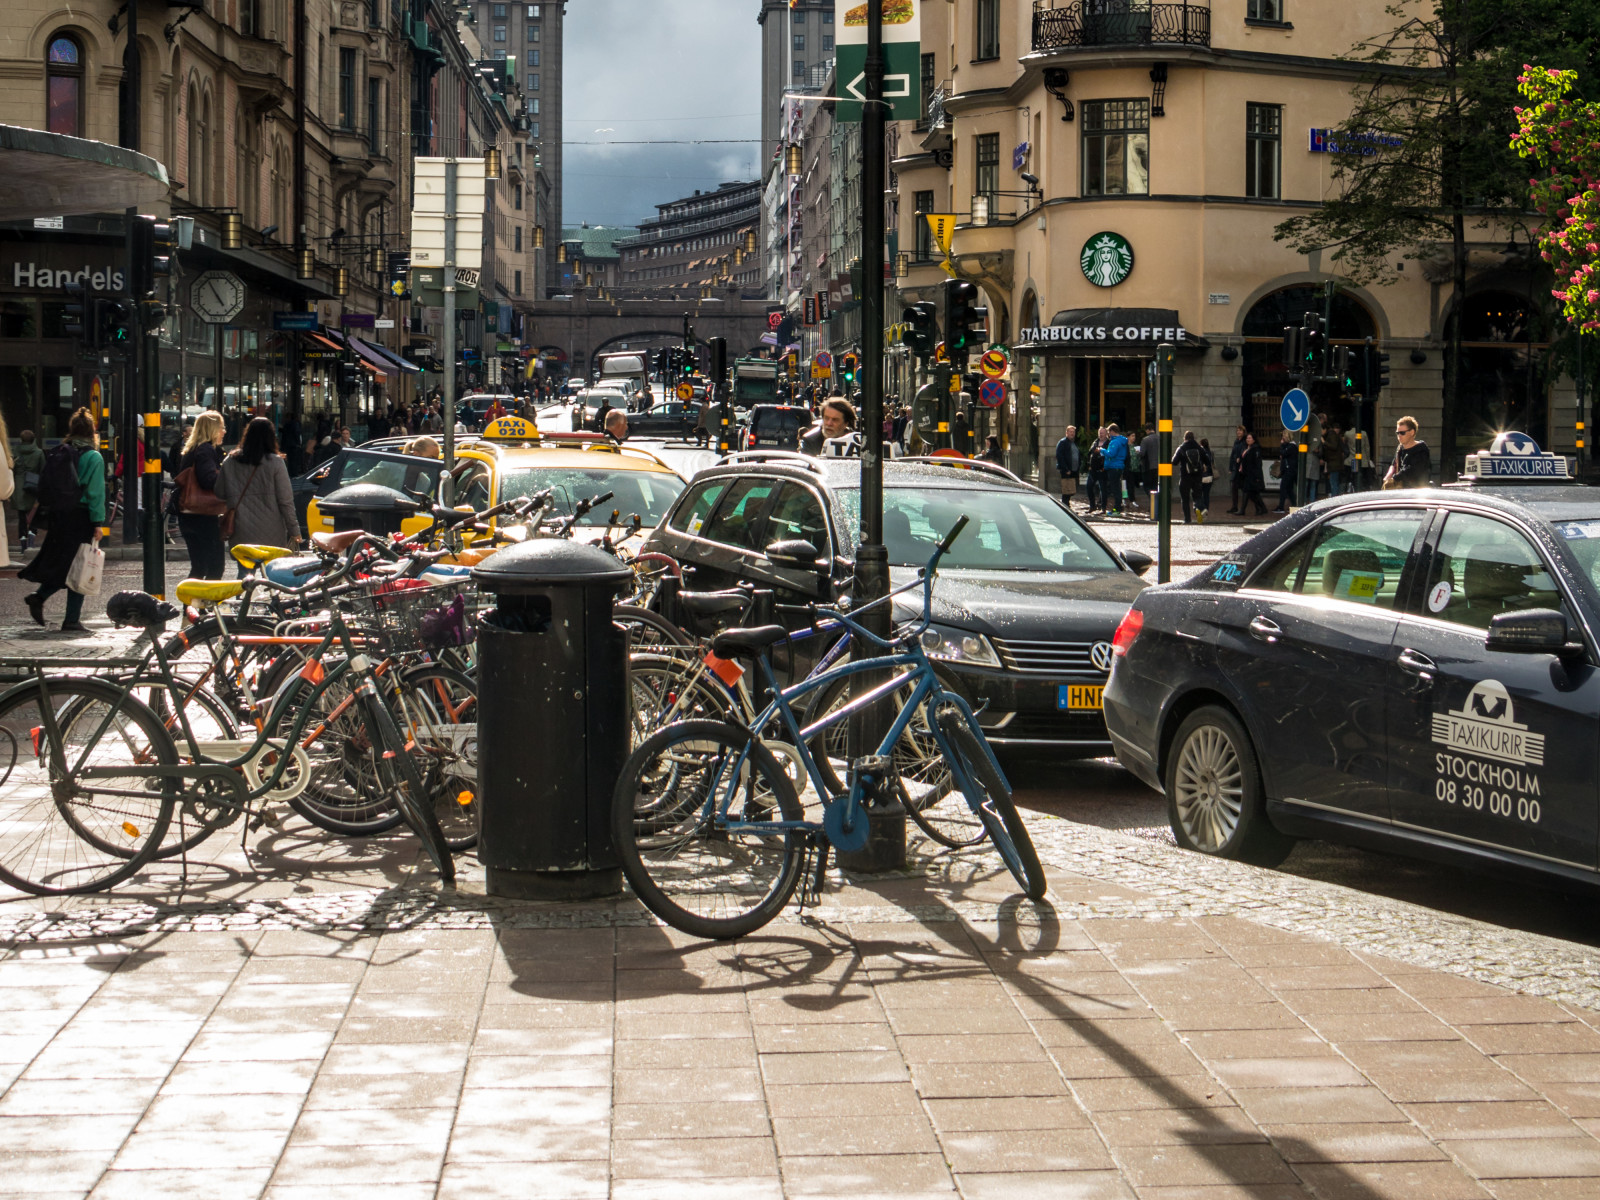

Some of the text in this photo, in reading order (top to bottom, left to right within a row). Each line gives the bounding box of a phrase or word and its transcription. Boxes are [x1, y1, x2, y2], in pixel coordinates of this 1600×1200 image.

[14, 262, 124, 291] Handels
[1020, 326, 1186, 342] STARBUCKS COFFEE
[499, 428, 526, 436] 020
[830, 441, 891, 458] TAI
[1492, 460, 1555, 475] TAXIKURIR
[1213, 563, 1237, 581] 470
[1434, 588, 1446, 604] F
[1451, 721, 1522, 757] TAXIKURIR
[1436, 752, 1540, 796] STOCKHOLM
[1436, 778, 1541, 823] 08 30 00 00
